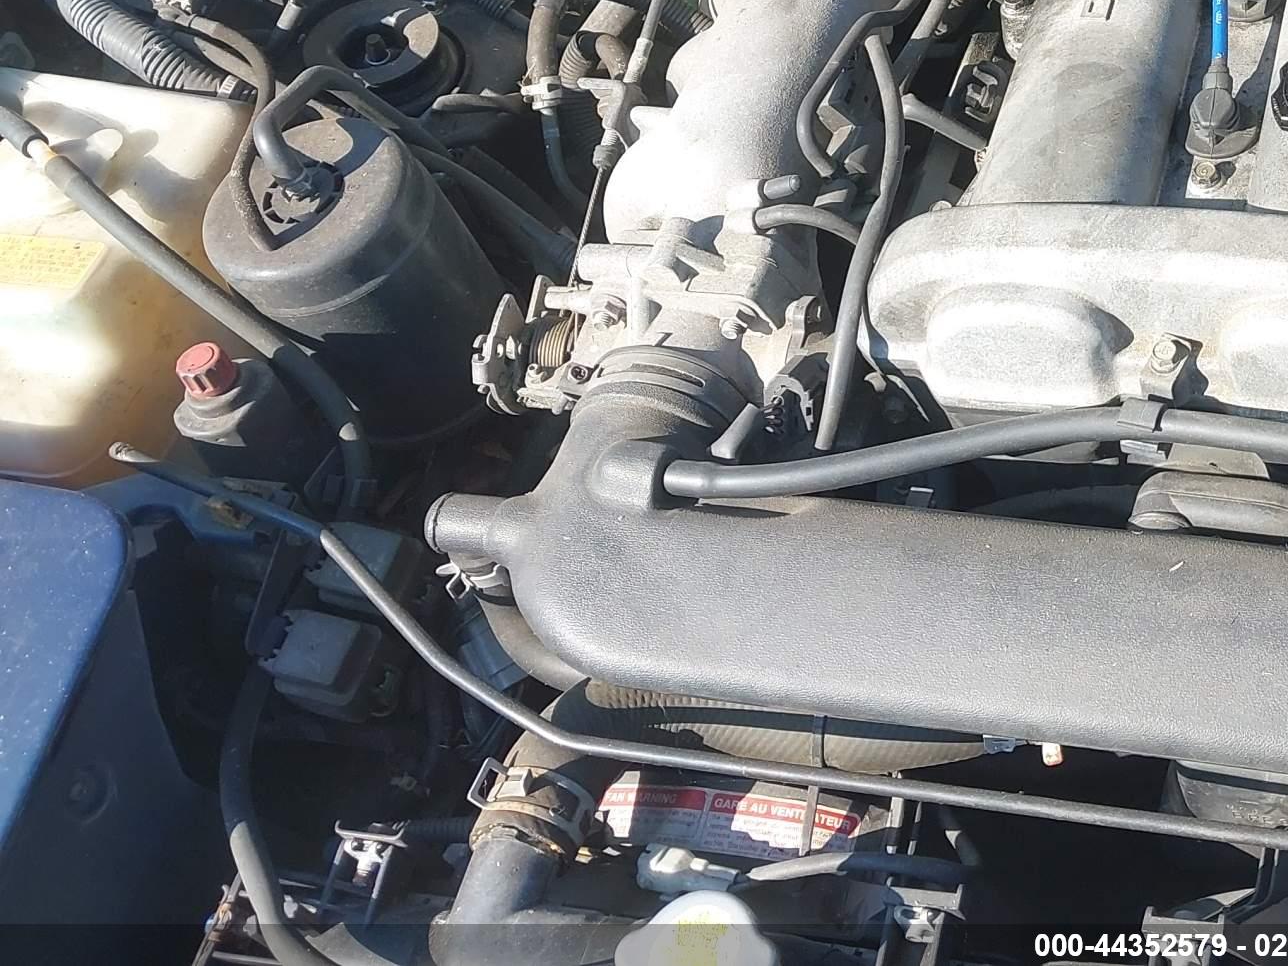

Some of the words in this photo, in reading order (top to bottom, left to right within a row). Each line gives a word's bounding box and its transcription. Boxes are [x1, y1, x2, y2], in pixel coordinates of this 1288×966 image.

[607, 791, 626, 802] FAN
[627, 791, 677, 805] WARNING
[714, 797, 748, 811] GARE
[750, 800, 768, 814] AU
[770, 804, 851, 831] VENTIATEUR
